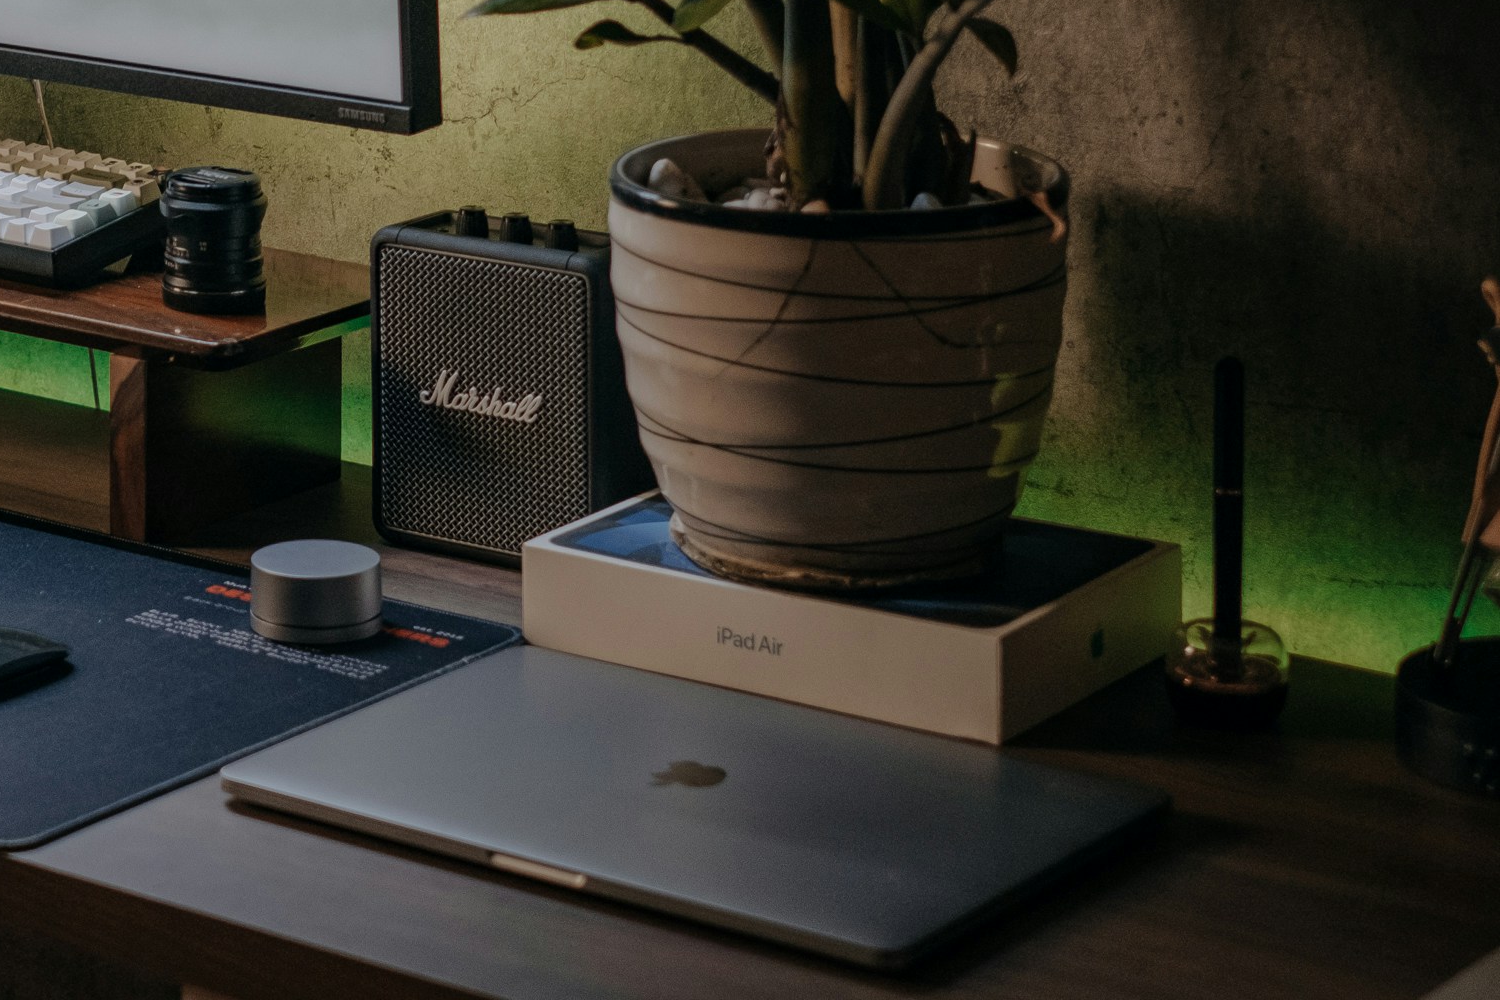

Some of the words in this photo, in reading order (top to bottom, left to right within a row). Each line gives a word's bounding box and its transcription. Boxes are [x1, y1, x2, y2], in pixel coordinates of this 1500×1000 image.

[338, 107, 386, 124] SAMSUNG
[419, 369, 542, 423] Marshall
[716, 626, 755, 651] iPad
[758, 635, 783, 656] Air
